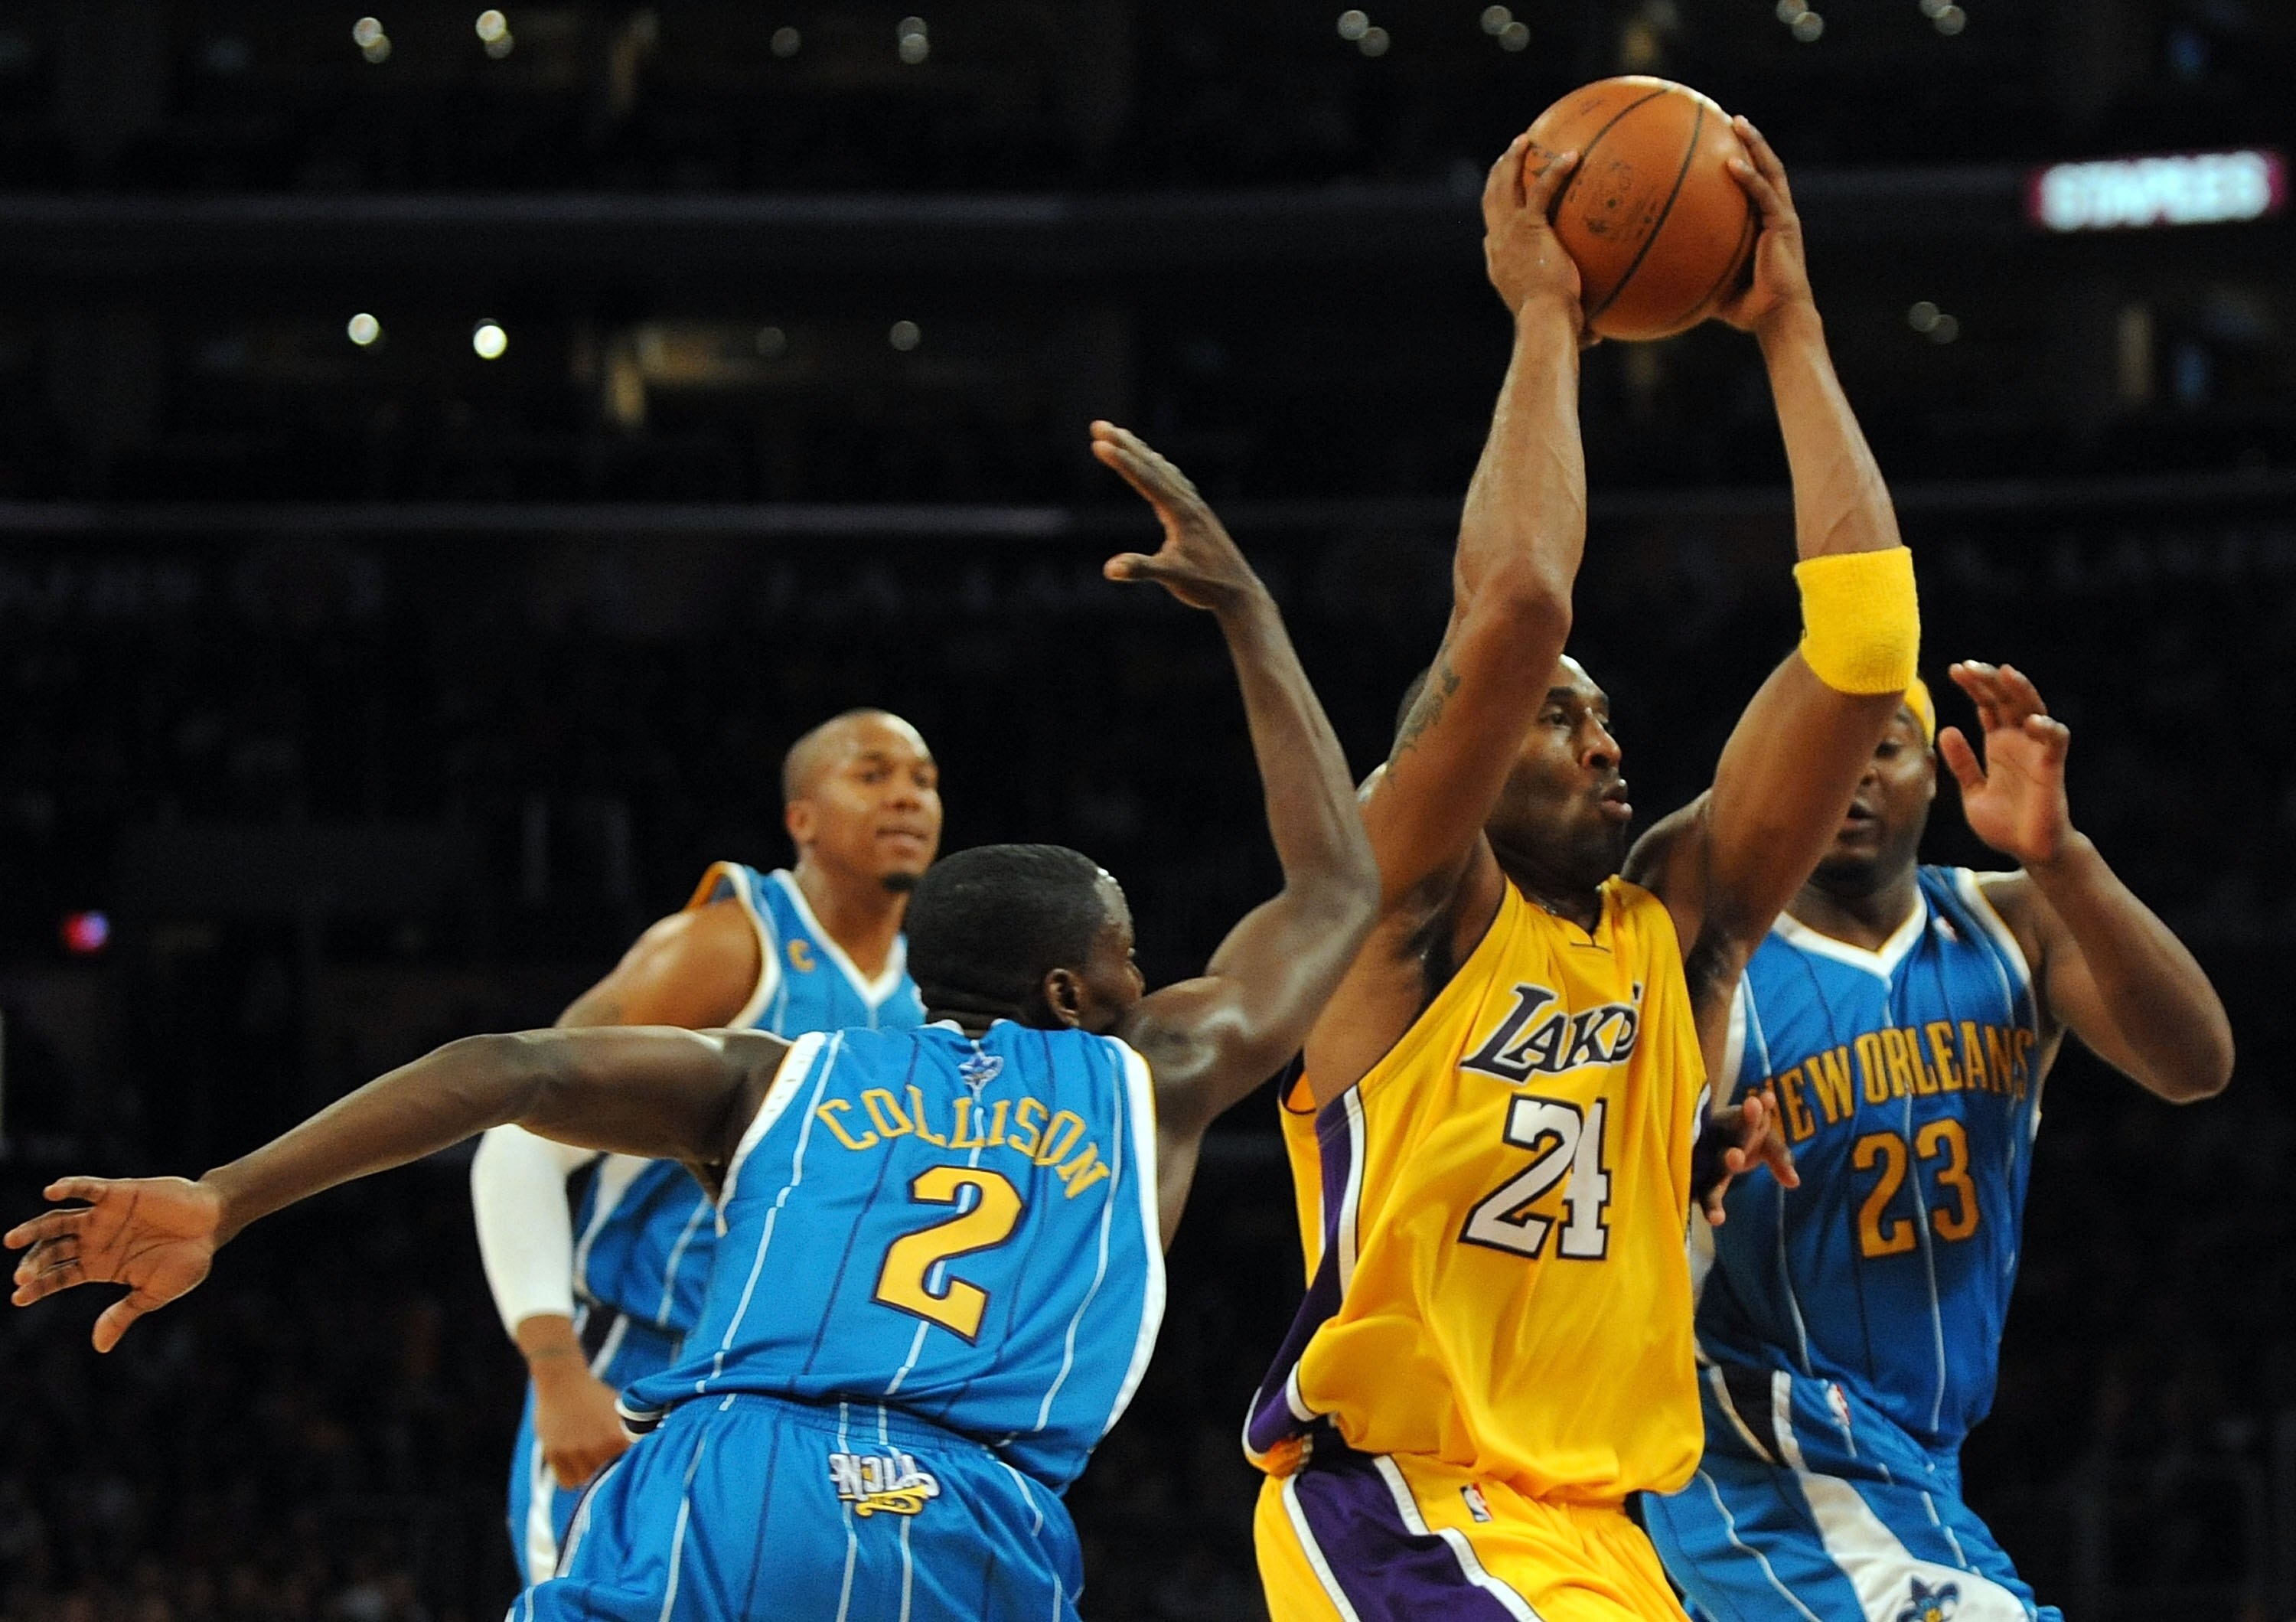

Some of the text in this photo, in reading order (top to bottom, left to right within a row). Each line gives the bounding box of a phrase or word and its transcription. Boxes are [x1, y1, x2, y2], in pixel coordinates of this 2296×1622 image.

[788, 939, 816, 971] C
[1854, 1020, 2034, 1103] ORLEANS
[816, 1085, 1110, 1199] COLLISON
[1457, 1092, 1612, 1261] 24
[1853, 1118, 1980, 1258] 23
[871, 1164, 1026, 1347] 2
